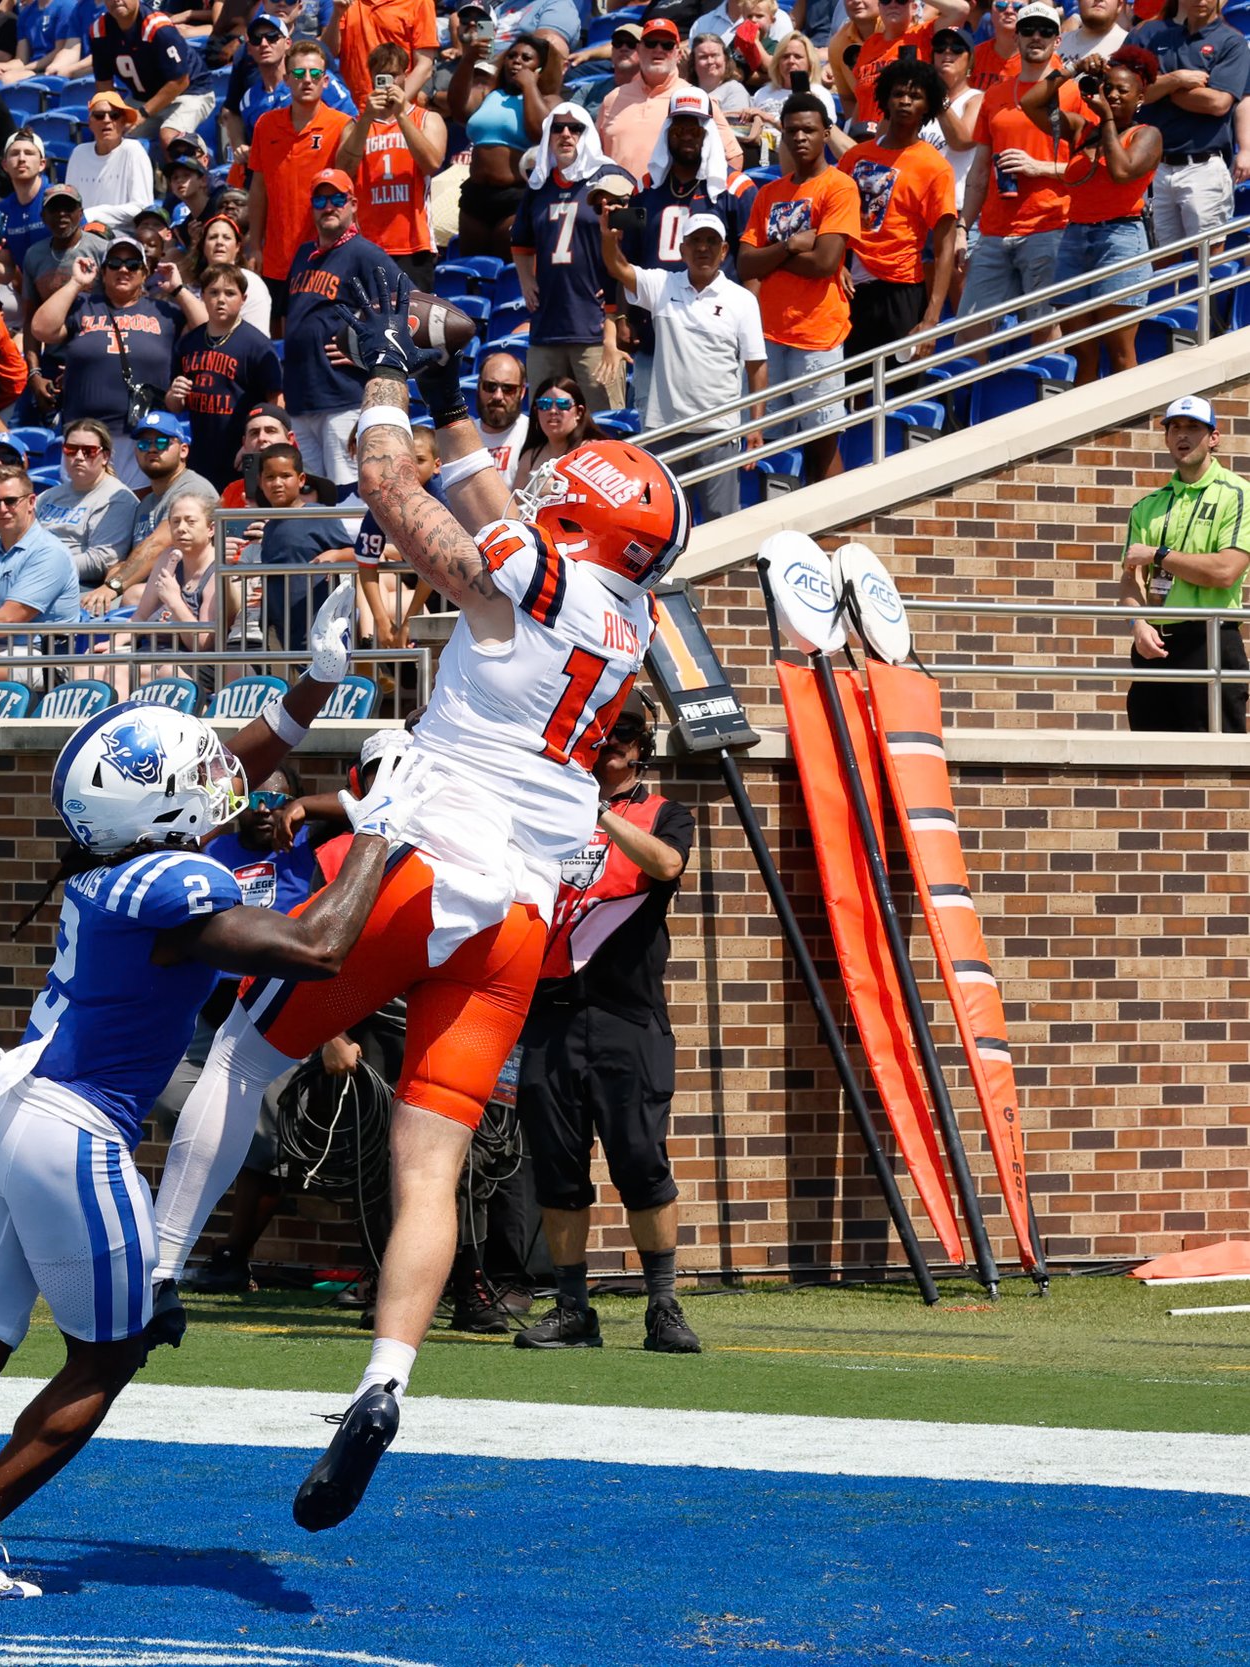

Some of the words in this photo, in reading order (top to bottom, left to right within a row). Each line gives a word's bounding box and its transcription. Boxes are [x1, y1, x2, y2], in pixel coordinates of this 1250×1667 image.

[166, 45, 182, 64] 9
[116, 55, 146, 93] 9
[311, 135, 323, 151] I
[365, 132, 409, 155] IGHTIN
[382, 154, 394, 180] 1
[370, 184, 409, 205] ILLINI
[550, 201, 579, 264] 7
[658, 205, 691, 262] 0
[290, 269, 341, 301] ILLINOIS
[79, 314, 162, 337] ILLNOIS
[713, 305, 723, 317] I
[182, 350, 238, 381] ILLINOIS
[187, 391, 233, 415] OTBALL
[568, 450, 640, 505] ILLINOIS
[479, 523, 526, 574] 14
[793, 573, 830, 598] ACC
[869, 584, 896, 608] ACC
[603, 610, 640, 658] RUSH
[653, 598, 710, 691] 1
[40, 688, 103, 719] DUKE
[214, 685, 282, 718] DUKE
[316, 684, 368, 718] UKE
[539, 646, 638, 774] 14
[680, 703, 703, 720] PRO
[707, 696, 738, 716] DOWN
[77, 824, 100, 846] 2
[182, 874, 213, 915] 2
[240, 879, 275, 890] OLLEGE
[1002, 1106, 1024, 1204] Gilman
